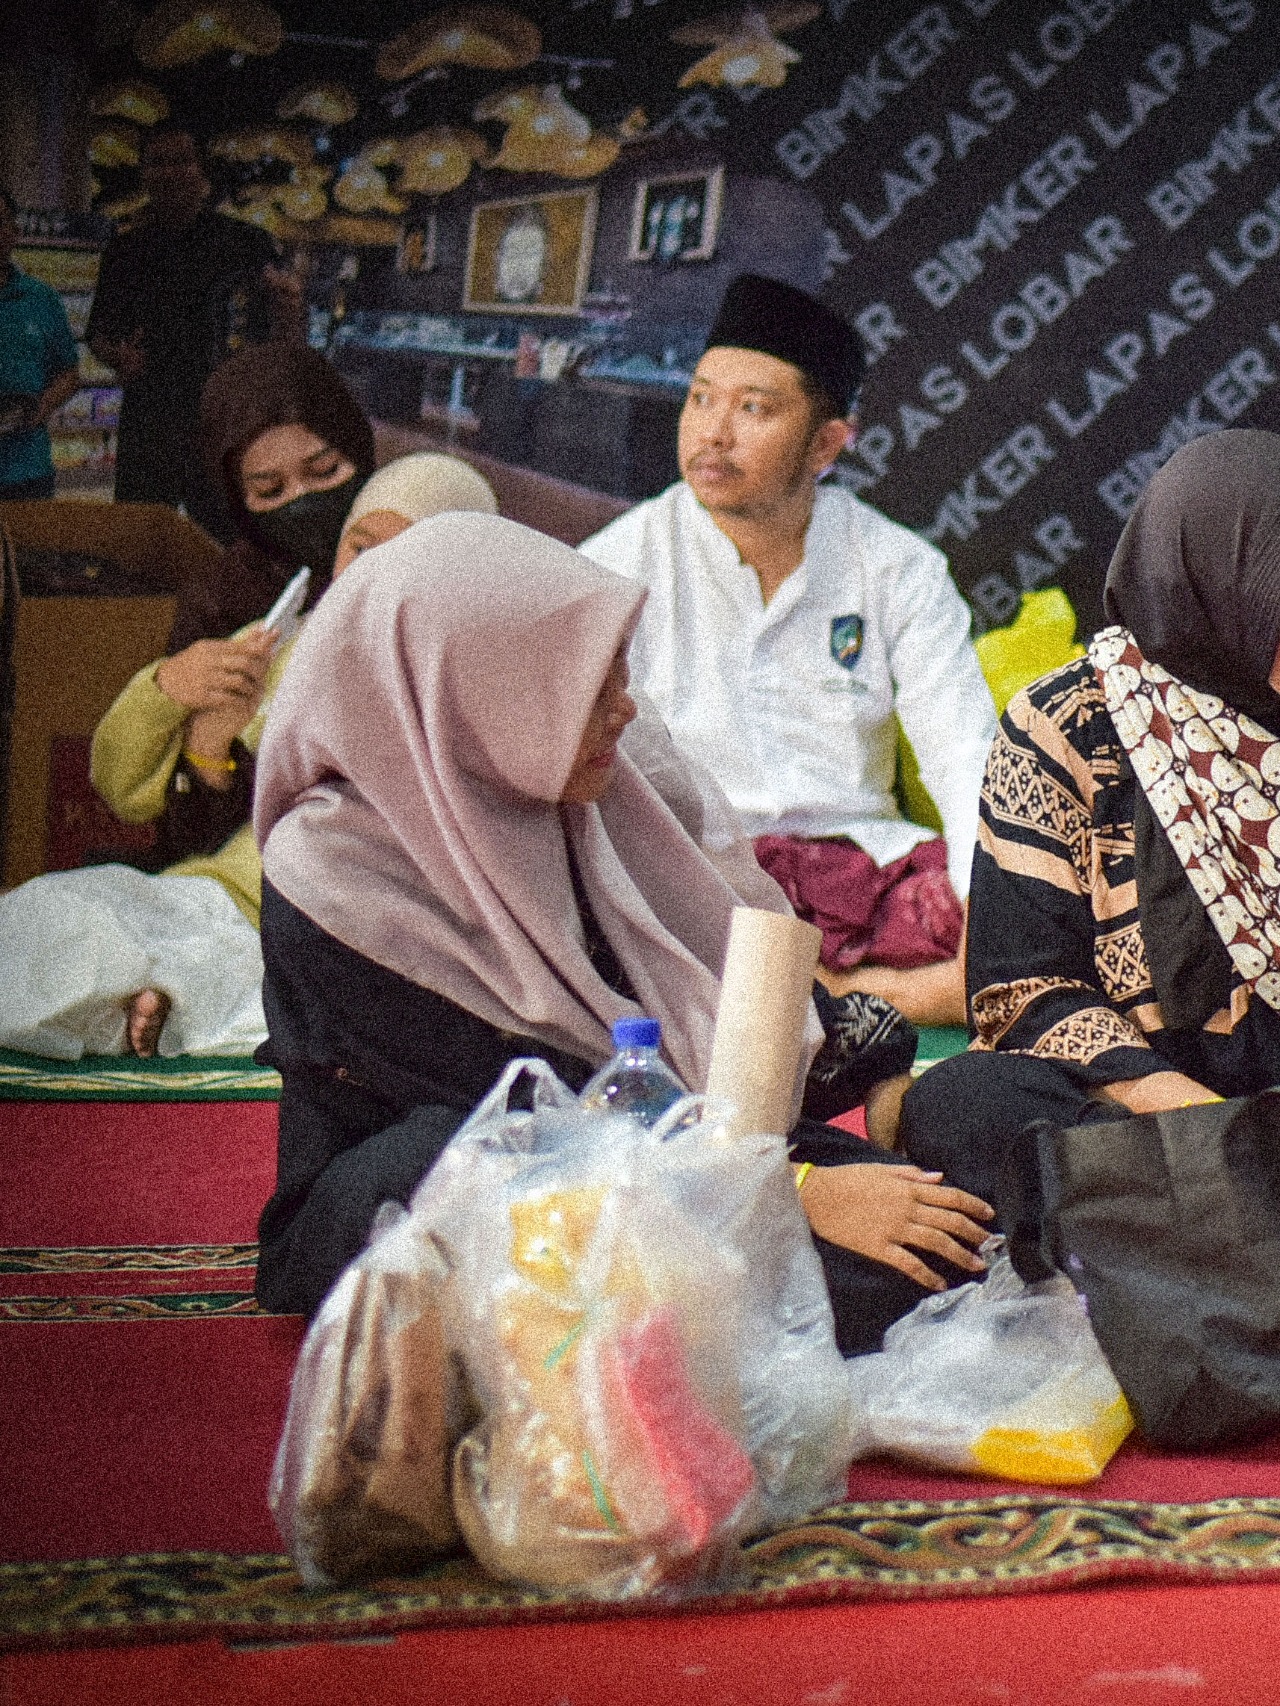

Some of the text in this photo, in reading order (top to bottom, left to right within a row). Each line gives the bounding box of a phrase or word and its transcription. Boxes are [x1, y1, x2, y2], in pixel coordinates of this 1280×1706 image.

[776, 5, 960, 179] BIMKER
[842, 0, 1119, 240] LAPAS LOB
[912, 135, 1096, 309] BIMKER
[961, 214, 1135, 380] LOBAR
[1045, 273, 1216, 436] LAPAS
